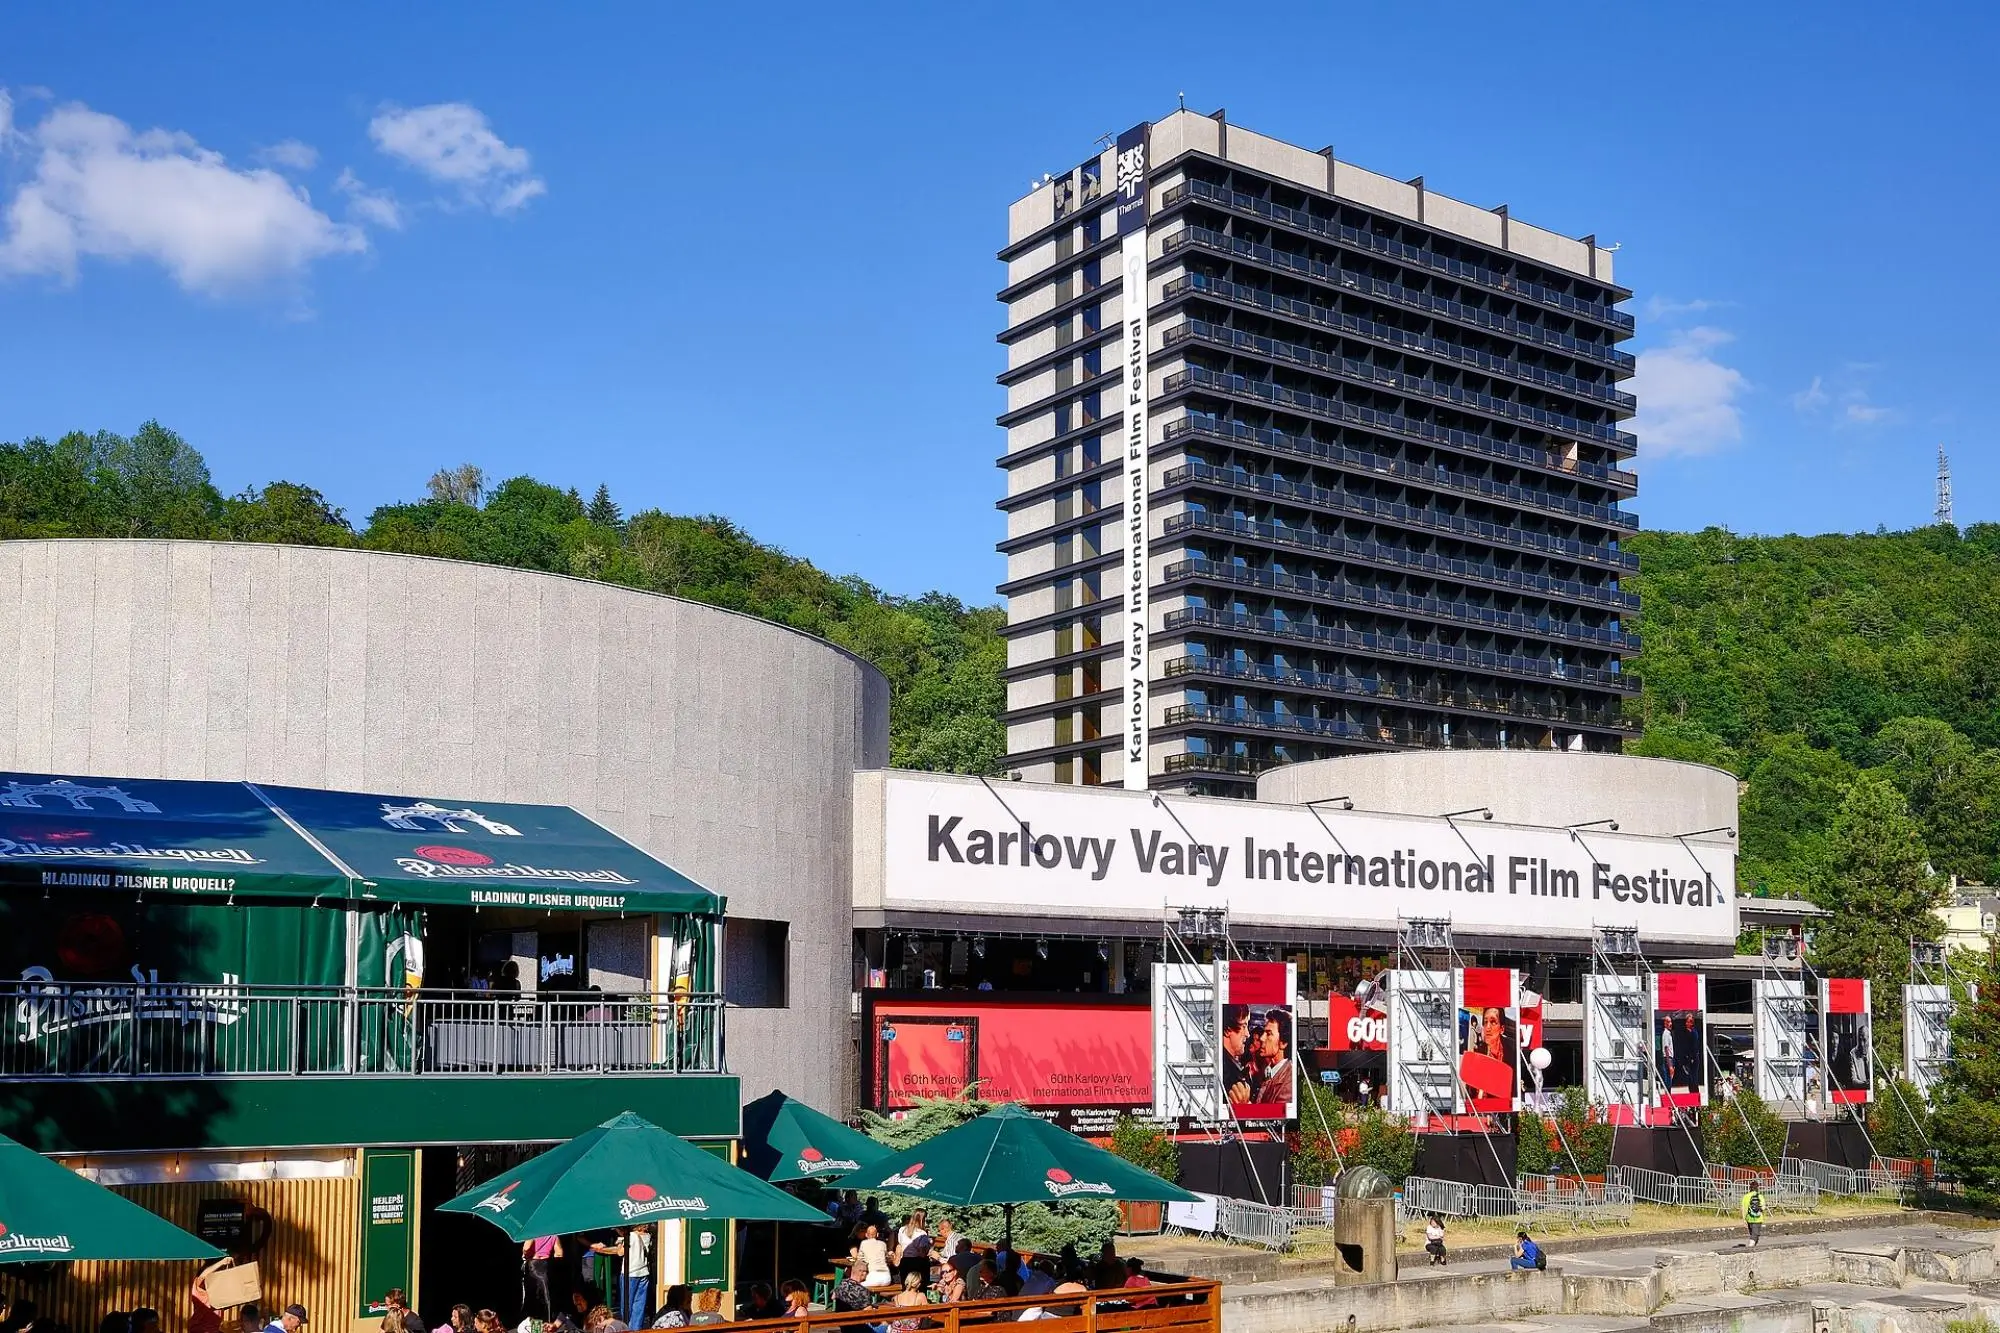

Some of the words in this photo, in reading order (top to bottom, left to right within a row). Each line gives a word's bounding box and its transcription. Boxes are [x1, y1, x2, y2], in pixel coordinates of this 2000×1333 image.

[1119, 195, 1144, 216] Thermal
[1130, 318, 1142, 406] Festival
[1130, 411, 1142, 462] Film
[1130, 467, 1142, 612] International
[1130, 620, 1144, 671] Vary
[1130, 678, 1144, 763] Karlovy
[111, 842, 256, 863] Urquell
[928, 814, 1116, 881] Karlovy
[1130, 828, 1229, 887] Vary
[1245, 836, 1494, 893] International
[1508, 856, 1580, 898] Film
[1592, 862, 1712, 907] Festival
[393, 857, 513, 879] Pilsner
[504, 863, 630, 884] Urquell
[42, 872, 111, 887] HLADINKU
[115, 874, 169, 890] PILSNER
[172, 877, 236, 892] URQUELL?
[470, 890, 526, 904] HLADINKU
[528, 894, 572, 907] PILSNER
[574, 895, 626, 909] URQUELL?
[18, 965, 133, 1043] Pilsner
[904, 1074, 929, 1085] 60th
[931, 1074, 963, 1085] Karlov
[1050, 1073, 1074, 1084] 60th
[1075, 1073, 1109, 1085] Karlovy
[1111, 1073, 1132, 1084] Vary
[889, 1087, 949, 1098] nternational
[979, 1088, 1012, 1098] estival
[1033, 1086, 1092, 1097] International
[1094, 1086, 1113, 1096] Film
[1114, 1086, 1149, 1096] Festival
[1070, 1124, 1083, 1132] Film
[1083, 1124, 1105, 1132] Festival
[618, 1198, 663, 1220] Pilsner
[659, 1195, 706, 1211] Urquell
[10, 1233, 70, 1253] Urquell
